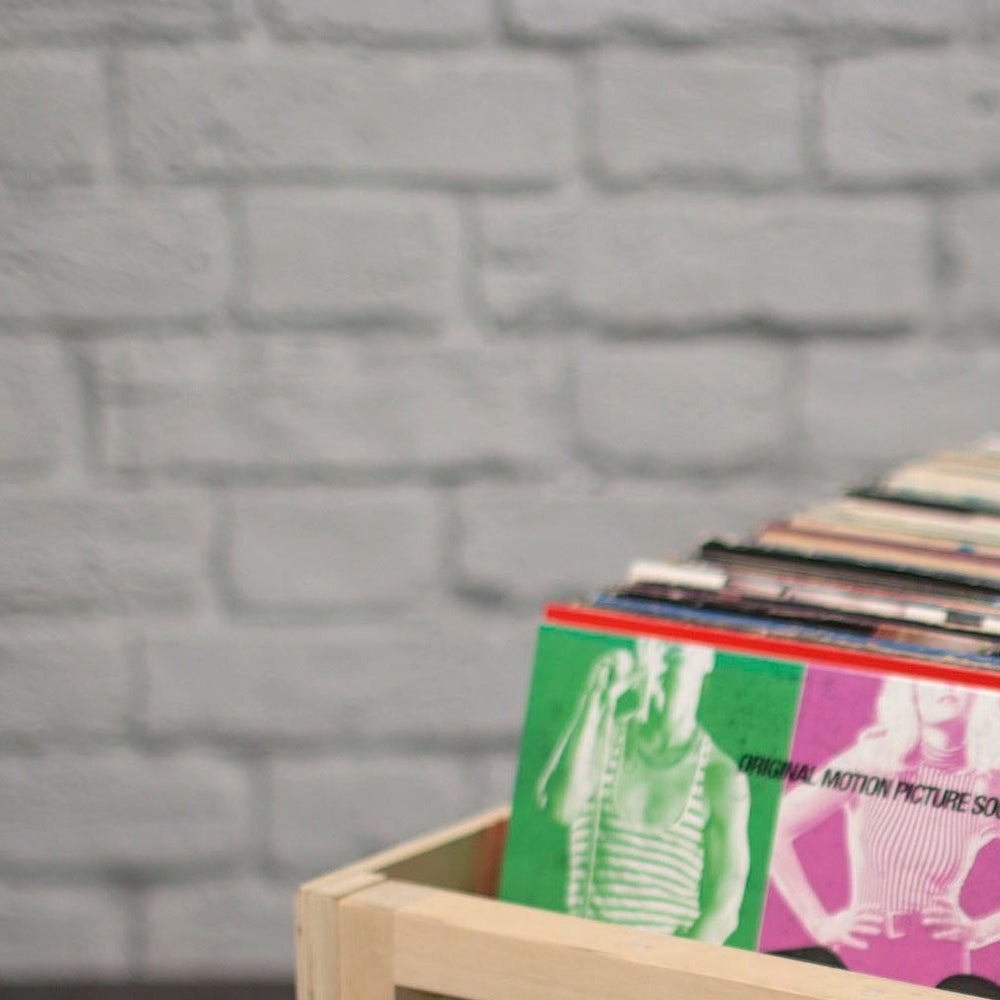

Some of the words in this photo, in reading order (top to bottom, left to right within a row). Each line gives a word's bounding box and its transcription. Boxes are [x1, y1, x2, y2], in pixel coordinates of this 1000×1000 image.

[738, 753, 816, 785] ORIGINAL
[820, 770, 893, 799] MOTION
[892, 781, 971, 813] PICTURE
